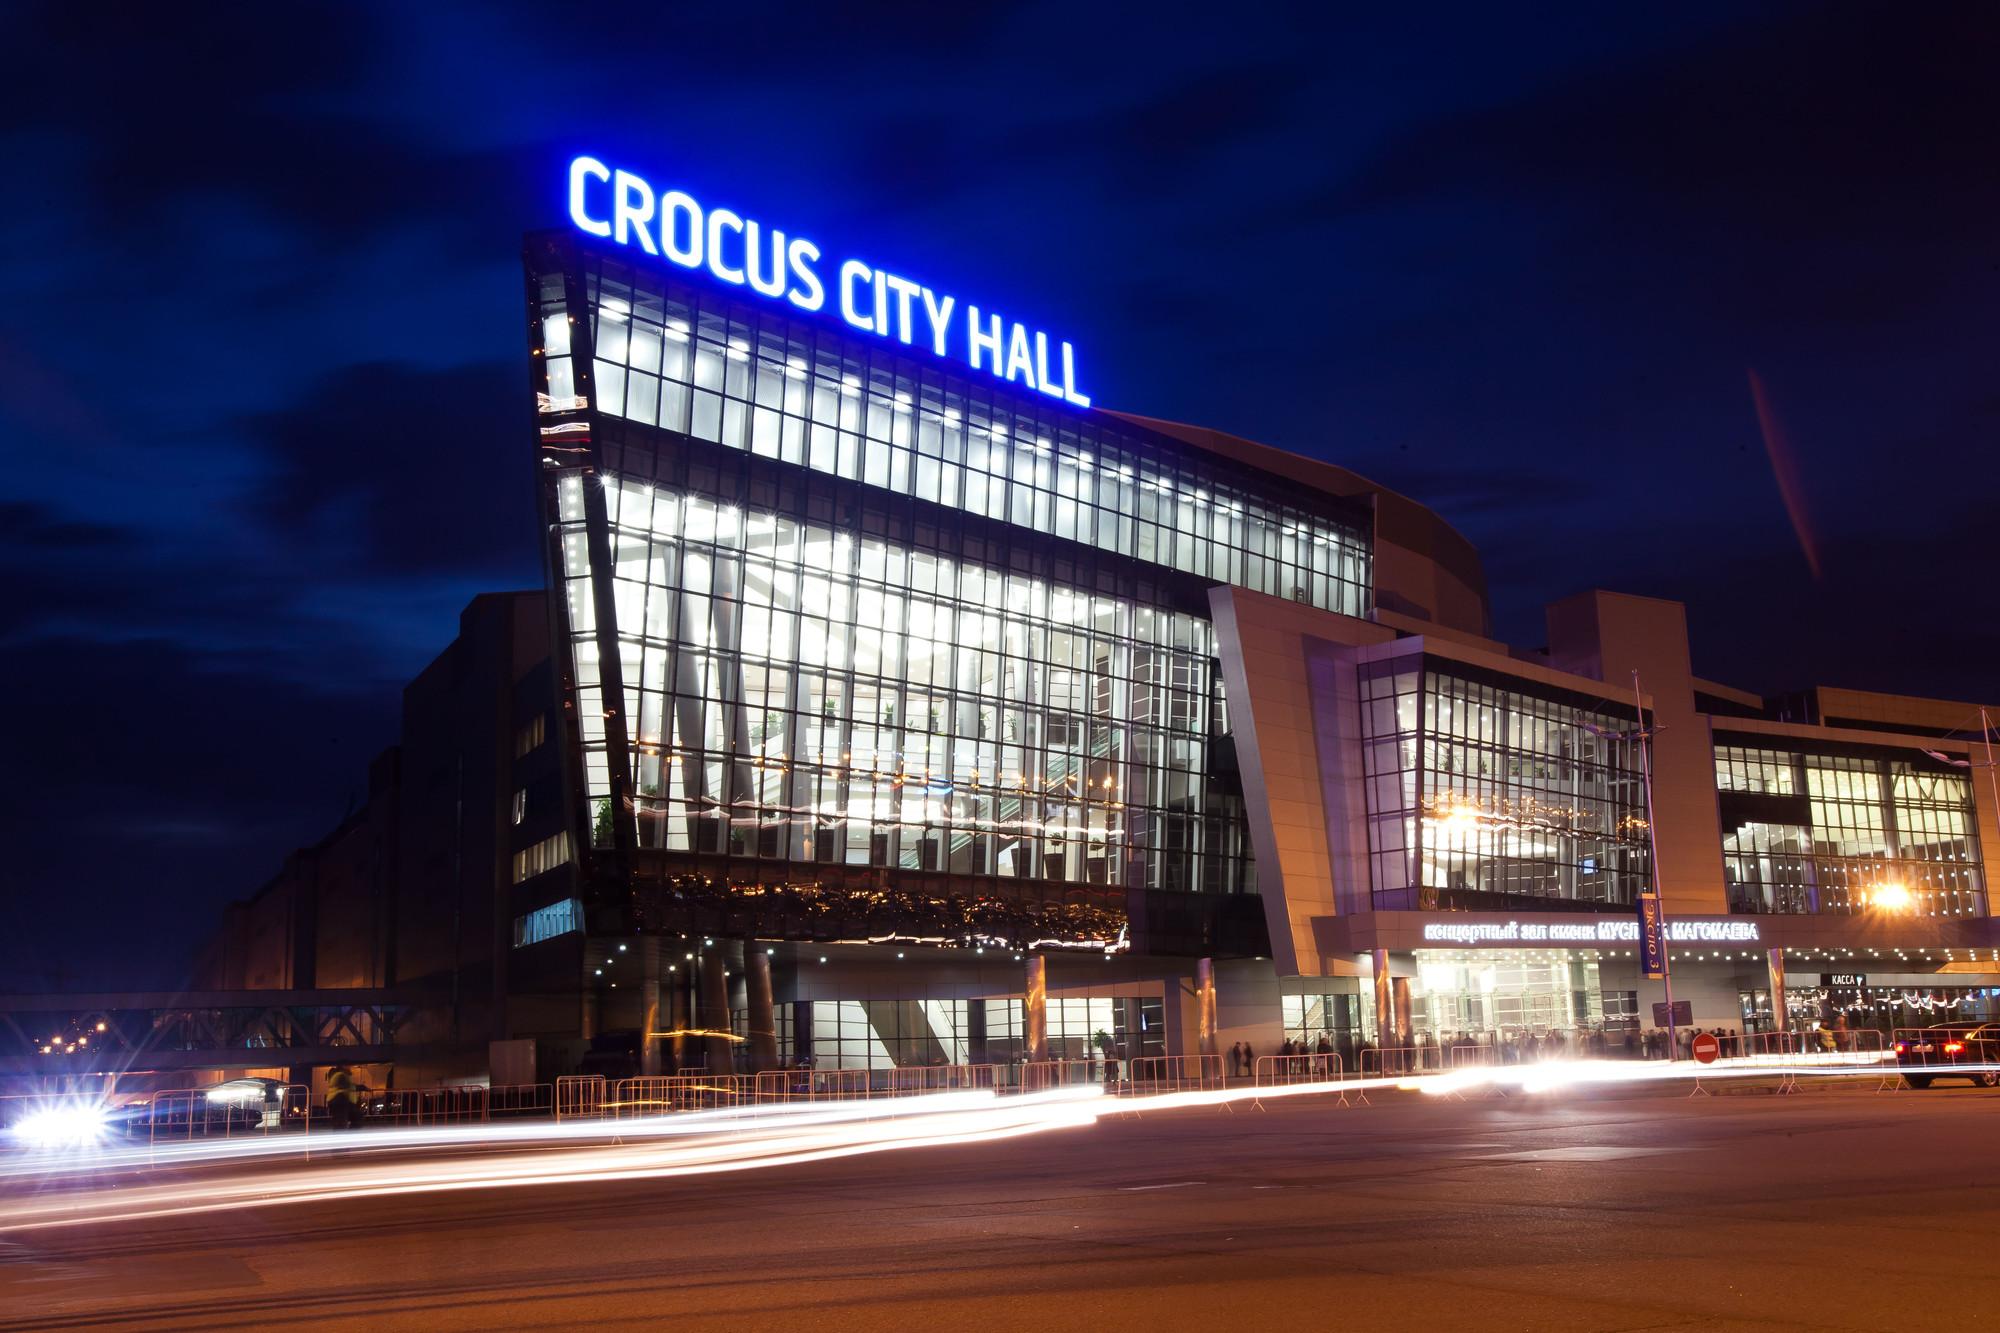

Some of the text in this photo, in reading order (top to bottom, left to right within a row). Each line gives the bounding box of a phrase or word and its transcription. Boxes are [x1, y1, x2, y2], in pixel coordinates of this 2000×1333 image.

[568, 155, 1092, 409] CROCUS CITY HALL
[1520, 925, 1548, 940] зал
[1671, 922, 1760, 940] МАГОМАЕВА
[1646, 904, 1659, 969] ЭКСПО 3
[1832, 974, 1856, 985] КАССА
